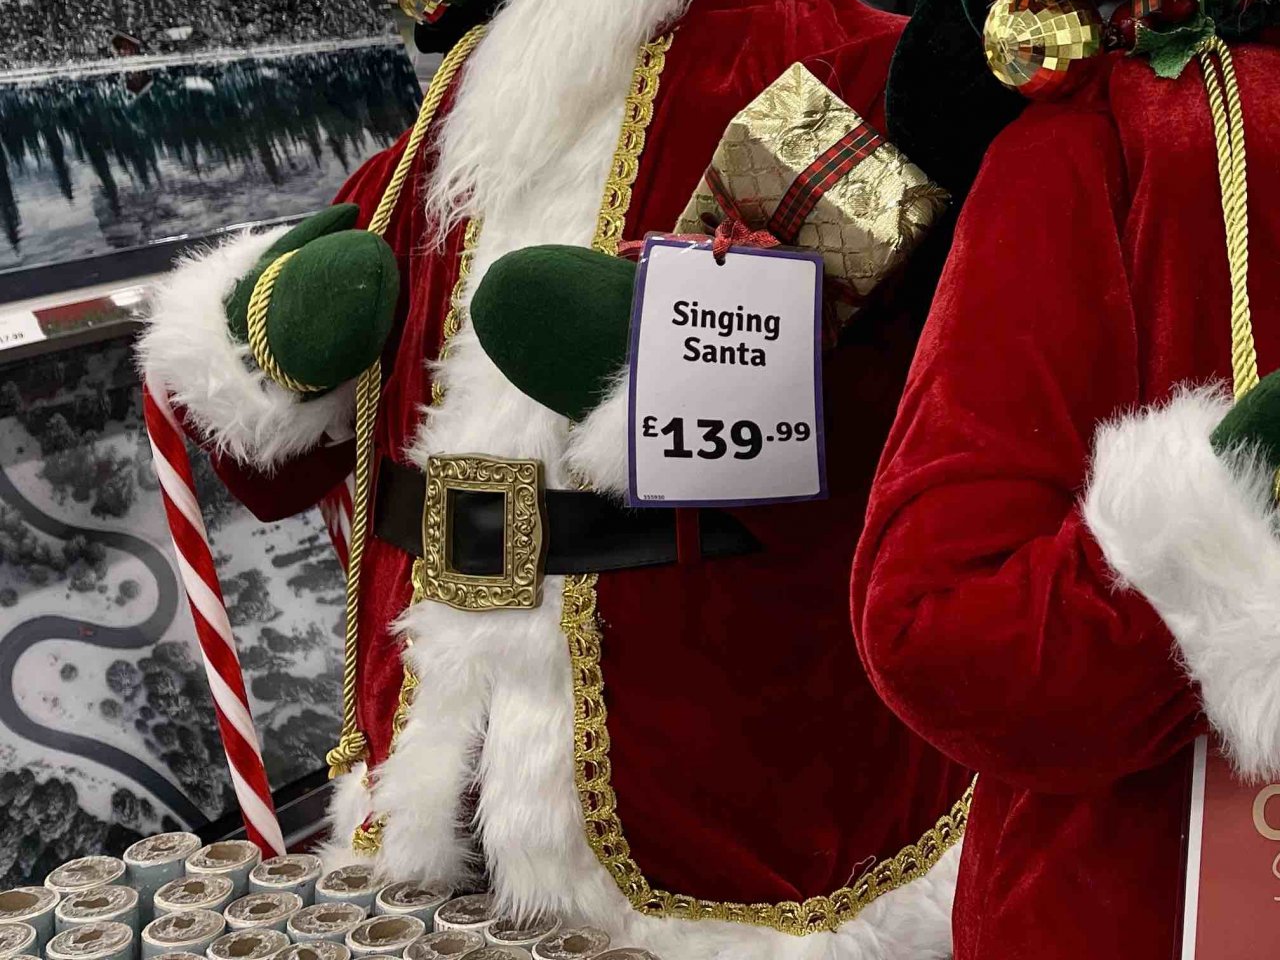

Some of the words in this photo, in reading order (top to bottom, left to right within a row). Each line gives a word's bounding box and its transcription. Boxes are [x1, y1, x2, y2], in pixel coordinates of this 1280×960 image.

[672, 300, 781, 341] Singing
[683, 337, 766, 367] Santa
[642, 415, 811, 460] £139.99
